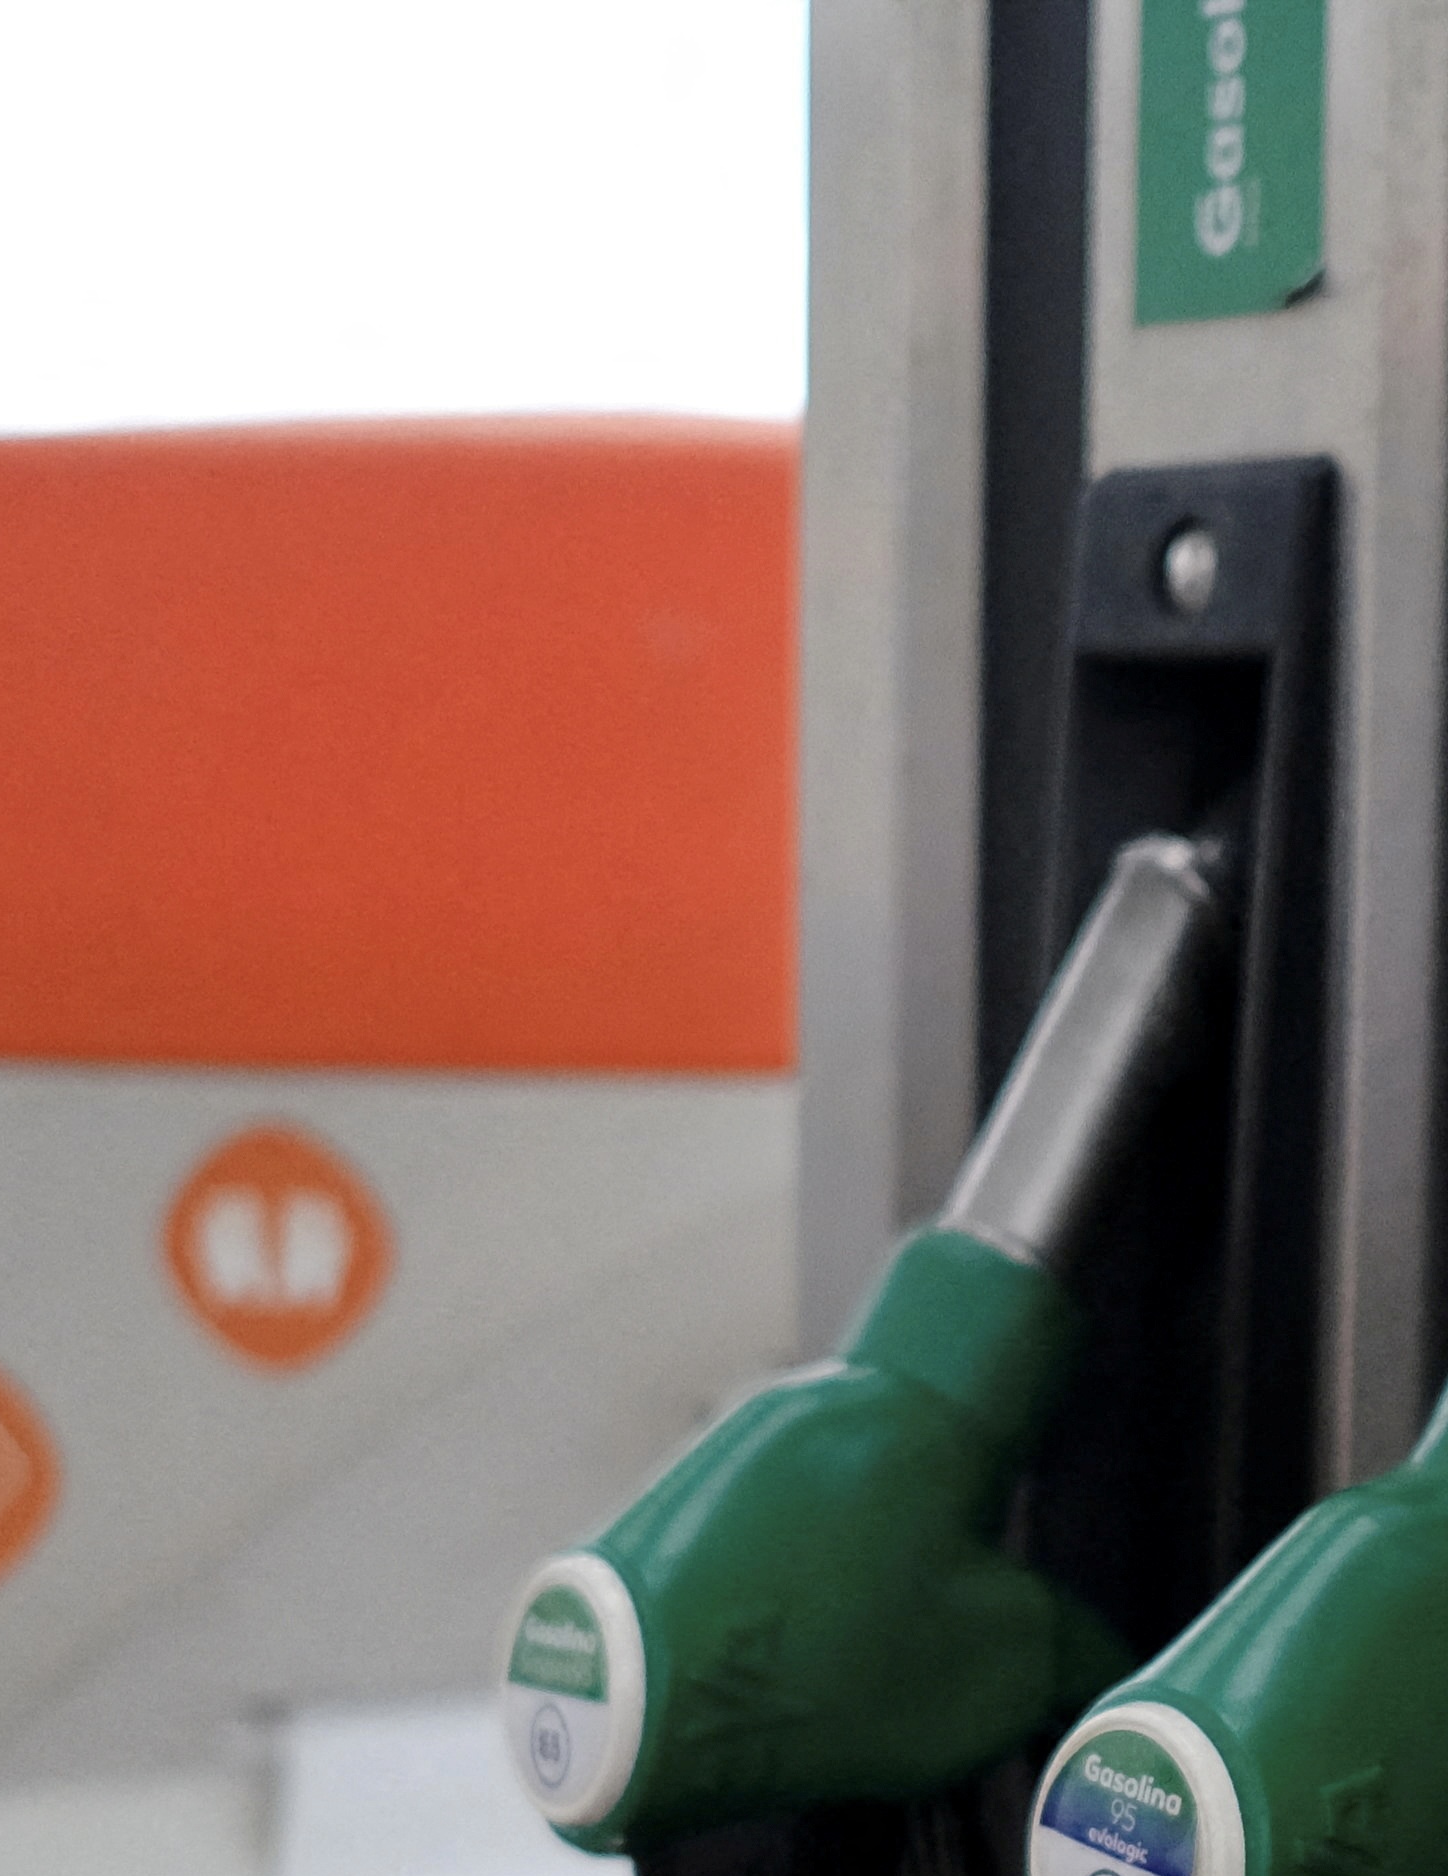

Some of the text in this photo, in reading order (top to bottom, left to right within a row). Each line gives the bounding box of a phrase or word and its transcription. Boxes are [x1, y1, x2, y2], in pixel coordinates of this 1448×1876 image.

[1083, 1753, 1183, 1817] Gasolina
[1110, 1798, 1137, 1833] 95
[1088, 1825, 1149, 1865] evologic
